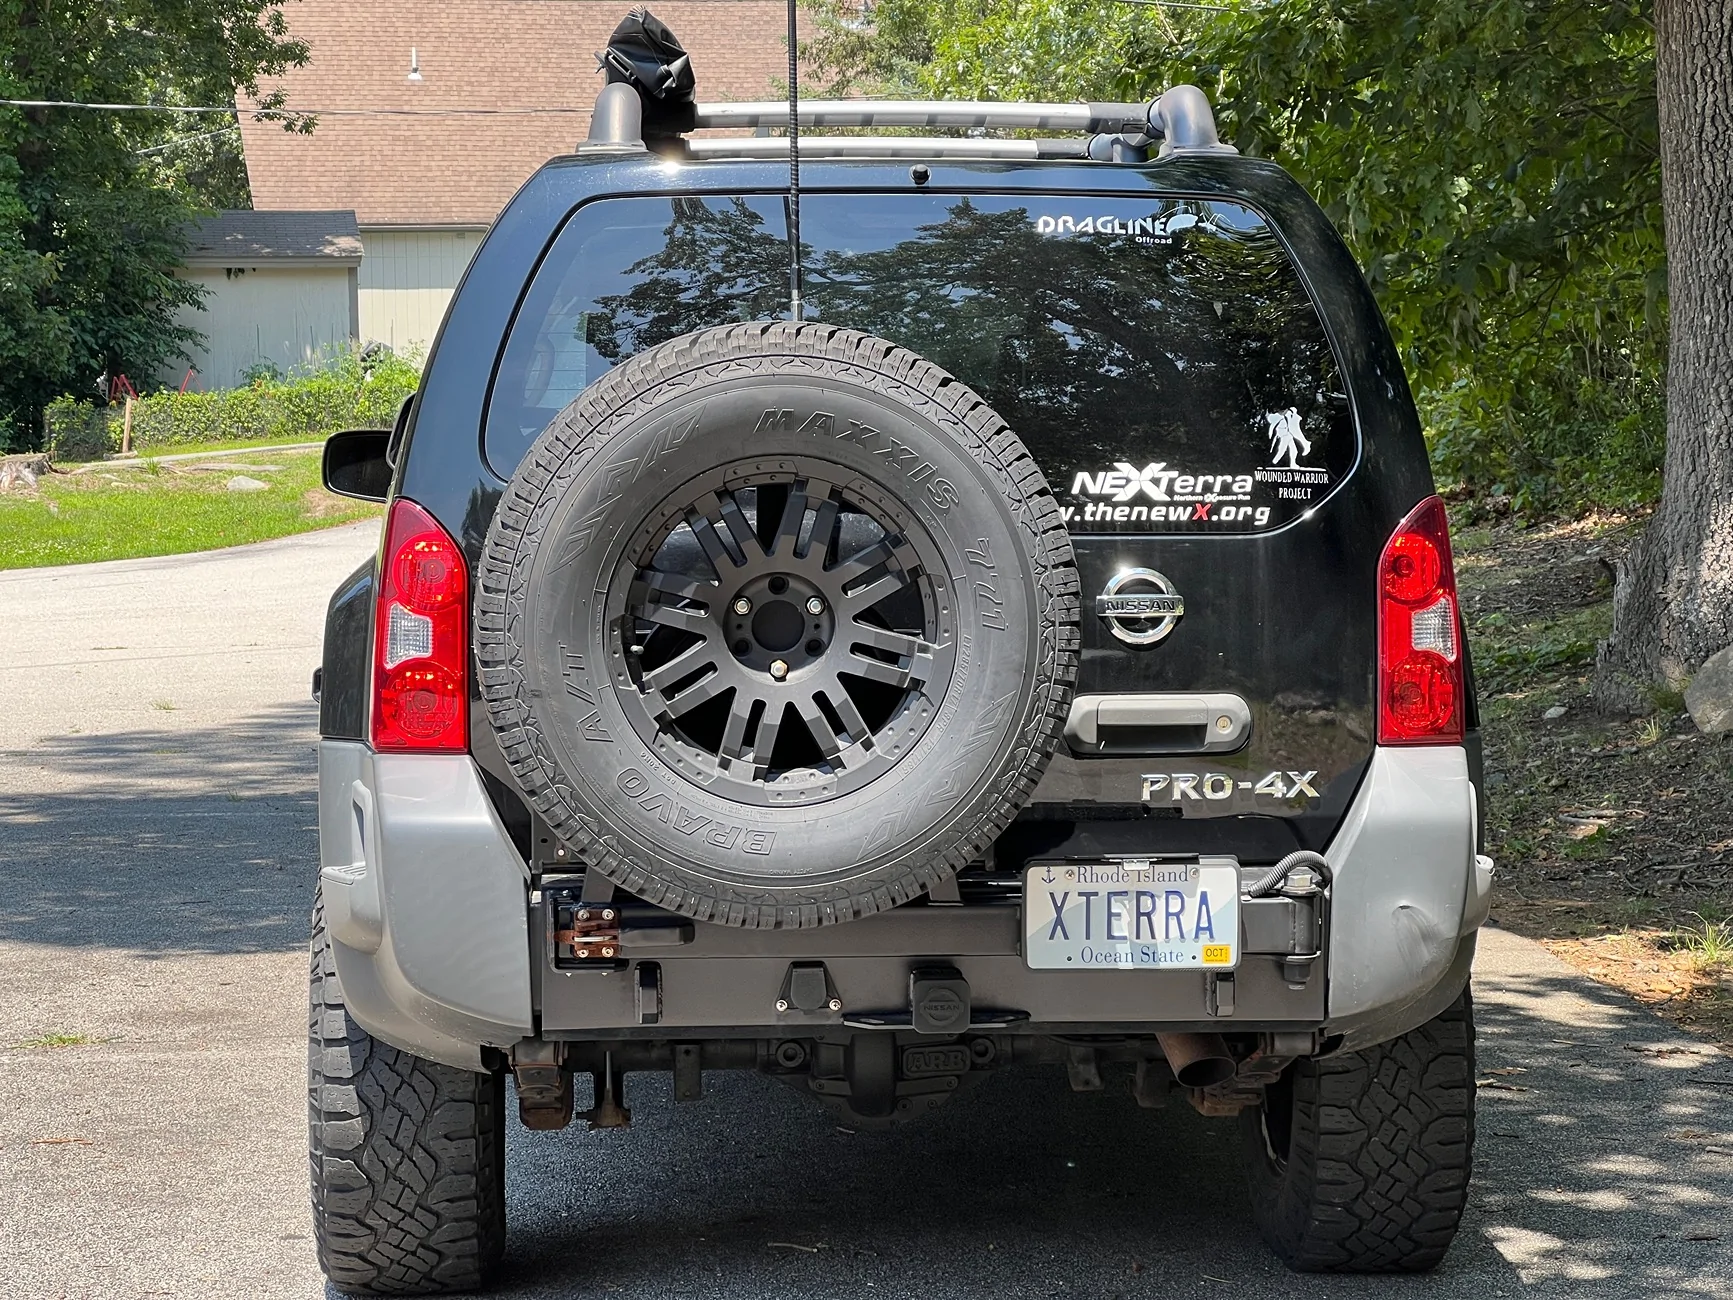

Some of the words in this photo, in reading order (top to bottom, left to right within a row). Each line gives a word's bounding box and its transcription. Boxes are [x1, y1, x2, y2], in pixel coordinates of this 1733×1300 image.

[1037, 215, 1171, 236] DRAGLINE
[1135, 236, 1173, 245] Offroad
[753, 407, 960, 510] MAXXIS
[1254, 470, 1293, 483] WOUNDED
[1293, 471, 1329, 484] WARRIOR
[1278, 487, 1312, 499] PROJECT
[964, 538, 1007, 631] 771
[1105, 600, 1175, 612] NISSAN
[1140, 770, 1321, 801] PRO-4X
[616, 767, 778, 856] BRAVO
[1076, 866, 1131, 884] Rhode
[1135, 866, 1189, 884] Island
[1048, 890, 1216, 942] XTERRA
[1081, 945, 1135, 964] Ocean
[1140, 945, 1185, 964] State
[1205, 948, 1224, 958] OCT
[908, 1051, 965, 1072] ARB
